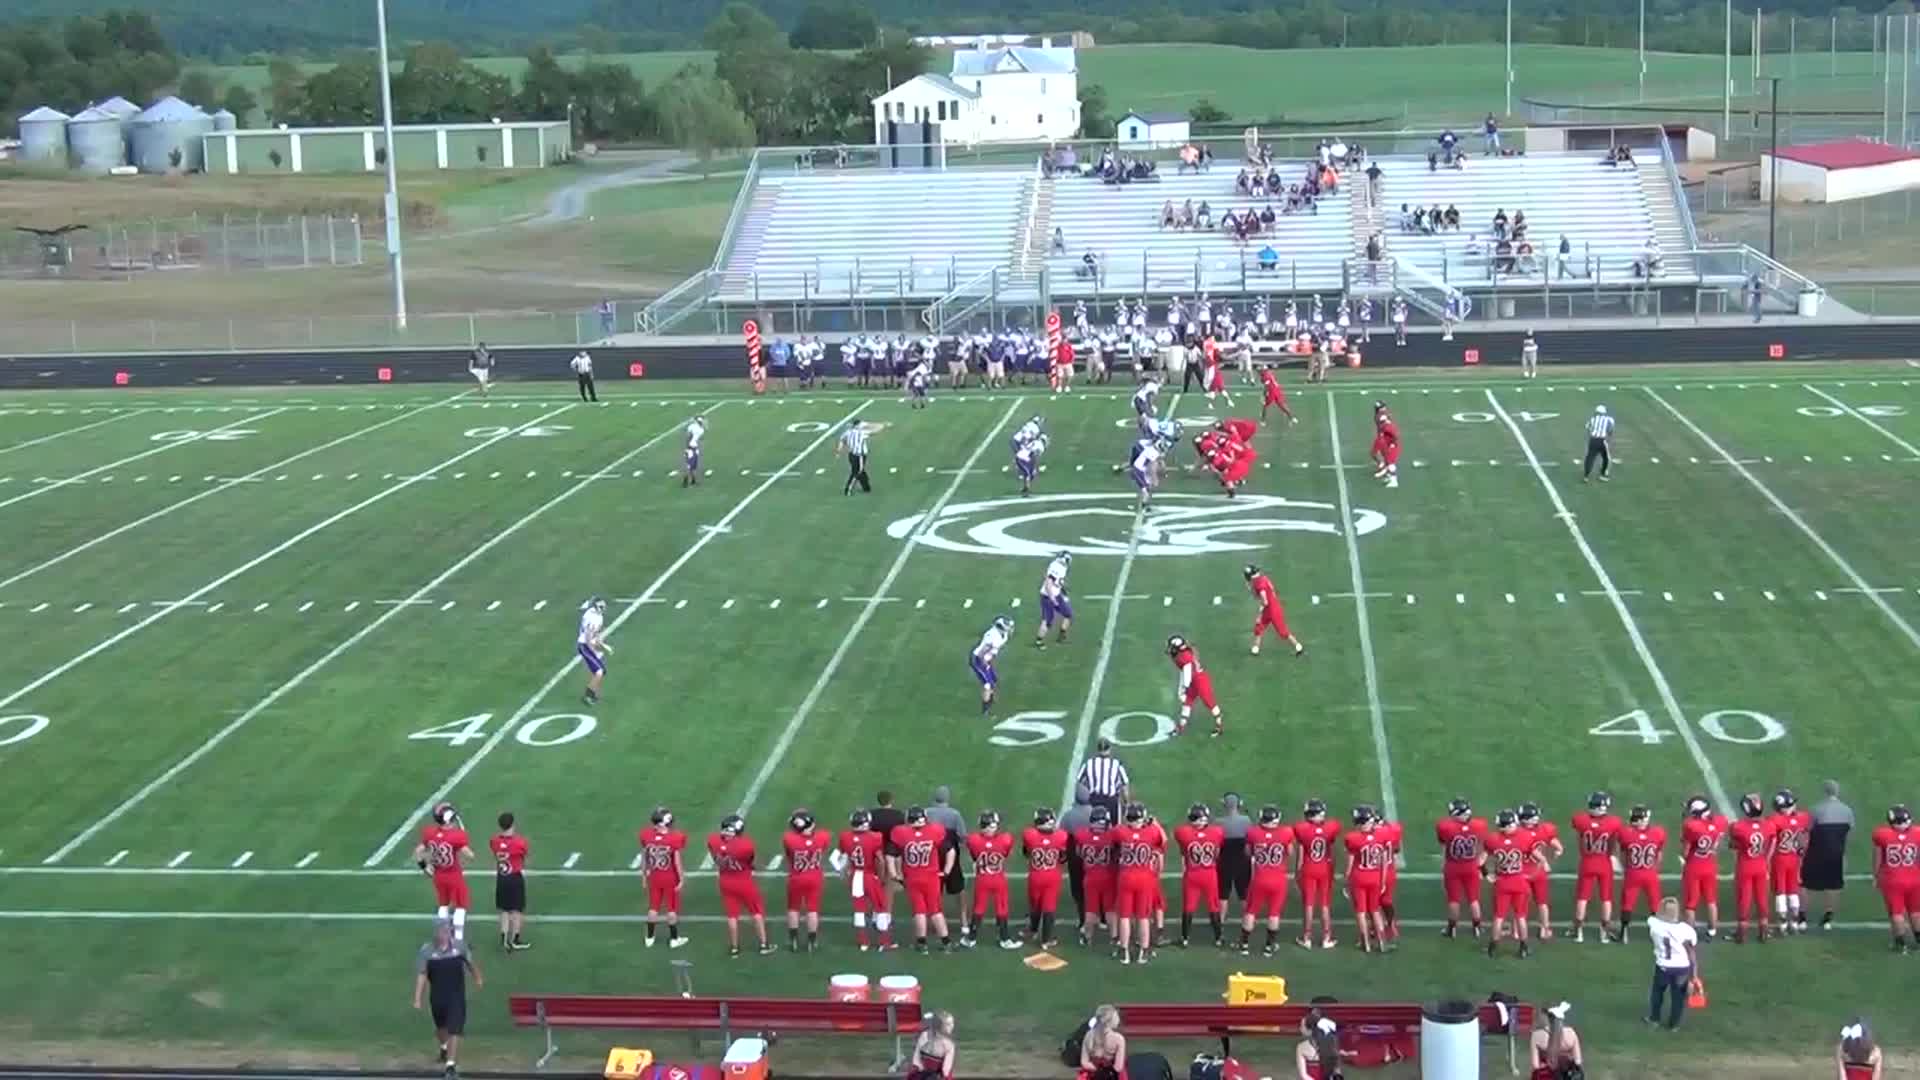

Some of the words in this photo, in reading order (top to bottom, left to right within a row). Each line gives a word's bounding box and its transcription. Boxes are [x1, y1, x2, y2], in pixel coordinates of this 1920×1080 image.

[408, 713, 598, 746] 40
[988, 711, 1176, 747] 50
[1589, 709, 1787, 744] 40
[904, 840, 932, 866] 67
